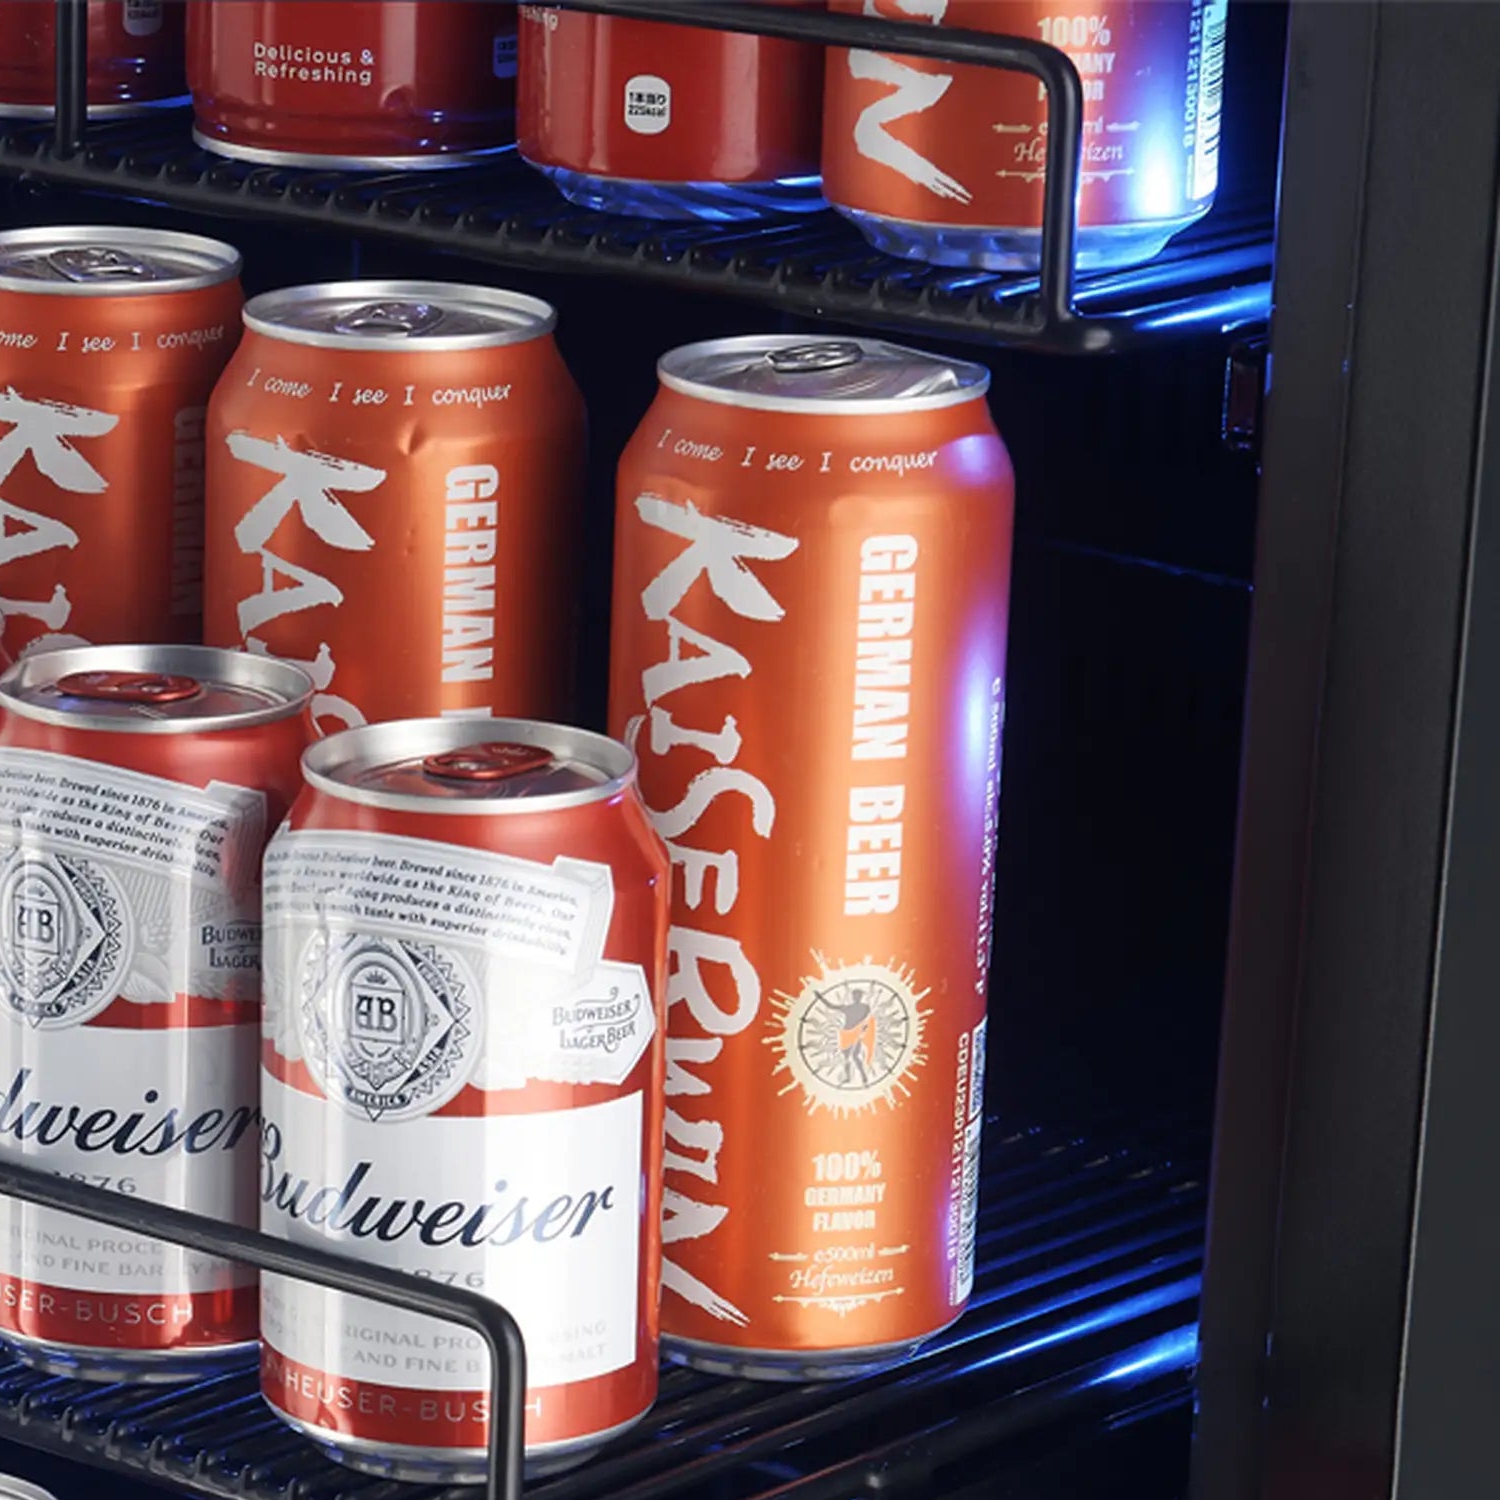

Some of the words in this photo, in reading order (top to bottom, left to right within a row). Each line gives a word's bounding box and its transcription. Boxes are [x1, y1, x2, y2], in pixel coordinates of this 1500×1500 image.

[1037, 15, 1111, 47] 100%
[254, 42, 352, 65] Delicious
[360, 49, 375, 64] &
[254, 61, 373, 85] Refreshing
[57, 332, 68, 351] I
[81, 334, 116, 353] see
[131, 332, 141, 352] I
[157, 324, 225, 352] conquer
[247, 368, 263, 388] I
[265, 376, 312, 397] come
[328, 382, 342, 402] I
[352, 385, 388, 406] see
[403, 385, 414, 405] I
[431, 383, 512, 408] conquer
[657, 429, 671, 448] I
[674, 437, 724, 462] come
[741, 448, 756, 467] I
[766, 451, 804, 471] see
[819, 452, 833, 473] I
[850, 450, 939, 476] conquer
[441, 463, 499, 683] GERMAN
[851, 533, 919, 762] GERMAN
[101, 787, 130, 803] since
[131, 794, 161, 810] 1876
[83, 834, 138, 854] superior
[844, 784, 907, 916] BEER
[400, 858, 444, 876] Brewed
[445, 866, 476, 883] since
[380, 892, 439, 910] produces
[422, 880, 444, 893] the
[447, 884, 481, 901] King
[624, 492, 800, 1328] KAISERWIN
[430, 916, 489, 937] superior
[355, 994, 399, 1031] AB
[551, 1000, 634, 1026] BUDWEISER
[560, 1028, 606, 1050] LAGER
[606, 1020, 636, 1051] BEER
[811, 1150, 883, 1182] 100%
[260, 1122, 615, 1247] Budweiser
[804, 1182, 886, 1208] GERMANY
[813, 1210, 876, 1232] FLAVOR
[61, 1259, 108, 1275] FINE
[789, 1265, 895, 1290] Hefeweizen
[345, 1326, 424, 1349] RIGINAL
[352, 1349, 397, 1369] AND
[405, 1355, 457, 1373] FINE
